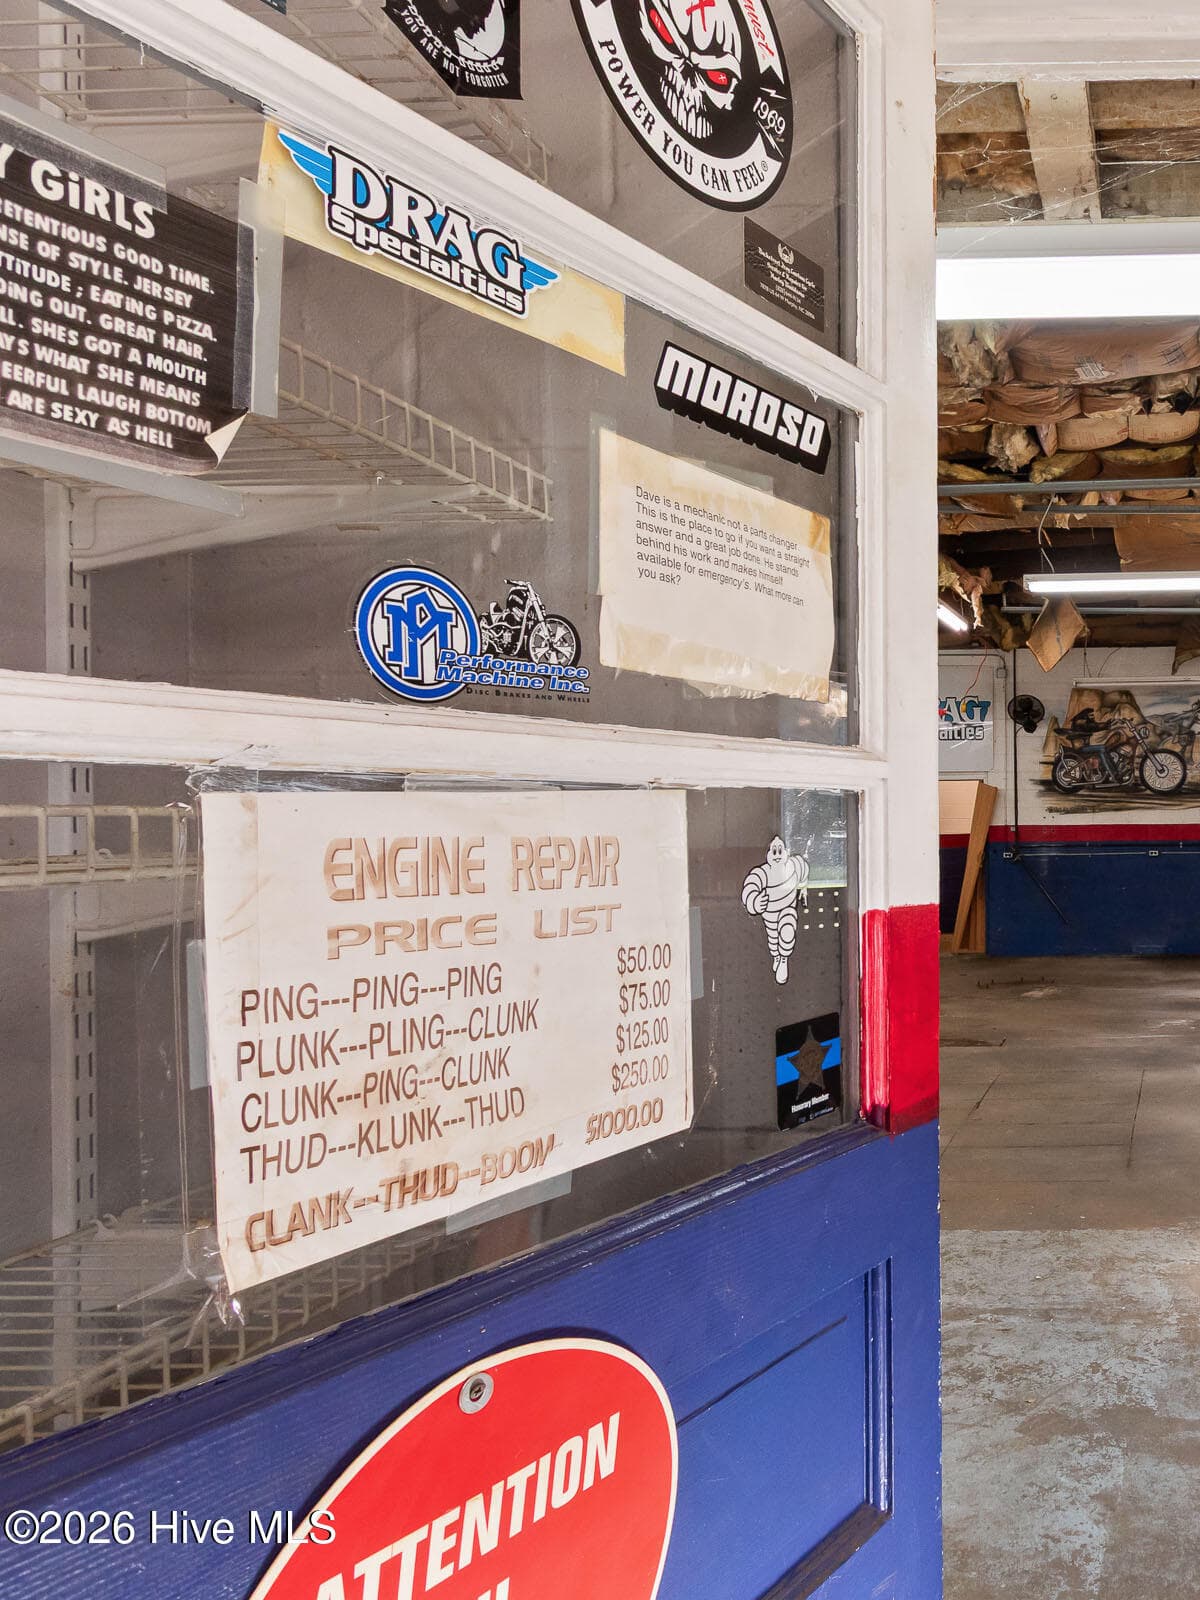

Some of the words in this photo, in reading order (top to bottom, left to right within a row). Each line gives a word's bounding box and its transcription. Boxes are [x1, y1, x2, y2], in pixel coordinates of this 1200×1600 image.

[400, 9, 420, 34] YOU
[419, 37, 440, 60] ARE
[442, 57, 460, 78] NOT
[464, 70, 510, 88] FORGOTTEN
[597, 39, 657, 135] POWER
[662, 130, 694, 176] YOU
[700, 163, 732, 193] CAN
[752, 97, 787, 135] 1969
[330, 147, 526, 293] DRAG
[36, 240, 61, 262] OF
[68, 251, 129, 286] STYLE.
[133, 275, 194, 309] JERSEY
[113, 242, 164, 276] GOOD
[330, 203, 525, 314] Specialties
[50, 296, 92, 325] OUT.
[99, 313, 157, 345] GREAT
[31, 317, 80, 346] SHES
[84, 335, 123, 359] GOT
[128, 348, 142, 366] A
[146, 352, 208, 387] MOUTH
[33, 342, 91, 375] WHAT
[97, 363, 135, 388] SHE
[139, 375, 201, 408] MEANS
[1, 360, 70, 397] EERFUL
[77, 383, 141, 416] LAUGH
[145, 402, 213, 435] BOTTOM
[7, 389, 46, 415] ARE
[50, 401, 100, 429] SEXY
[107, 416, 131, 437] AS
[135, 424, 174, 449] HELL
[657, 346, 827, 457] MOROSO
[636, 485, 661, 504] Dave
[663, 496, 672, 508] is
[674, 501, 680, 511] a
[683, 504, 726, 525] mechanic
[727, 519, 741, 530] not
[743, 524, 749, 533] a
[636, 501, 657, 518] This
[660, 511, 668, 521] is
[670, 514, 686, 527] the
[689, 520, 713, 535] place
[714, 528, 724, 538] to
[725, 532, 736, 543] go
[739, 534, 743, 544] if
[745, 538, 758, 550] you
[759, 545, 775, 556] want
[777, 551, 782, 559] a
[784, 552, 810, 568] straight
[636, 520, 672, 537] answer
[675, 531, 694, 543] and
[696, 537, 702, 546] a
[704, 539, 727, 553] great
[728, 545, 741, 557] job
[764, 559, 774, 569] He
[775, 563, 799, 577] stands
[636, 533, 671, 552] behind
[673, 543, 688, 557] his
[690, 550, 712, 564] work
[713, 556, 730, 569] and
[731, 562, 758, 577] makes
[637, 567, 657, 579] you
[659, 572, 681, 585] ask?
[636, 551, 681, 570] available
[684, 562, 696, 574] for
[754, 581, 774, 597] What
[775, 590, 792, 603] more
[792, 595, 804, 607] can
[437, 665, 545, 690] Machine
[550, 676, 591, 694] Inc.
[439, 649, 590, 679] Performance
[323, 836, 485, 902] ENGINE
[511, 834, 621, 892] REPAIR
[326, 912, 498, 961] PRICE
[533, 903, 622, 940] LIST
[617, 943, 671, 976] $50.00
[618, 978, 671, 1015] $75.00
[615, 1016, 670, 1056] $125.00
[611, 1053, 670, 1097] $250.00
[584, 1097, 664, 1146] $1000.00
